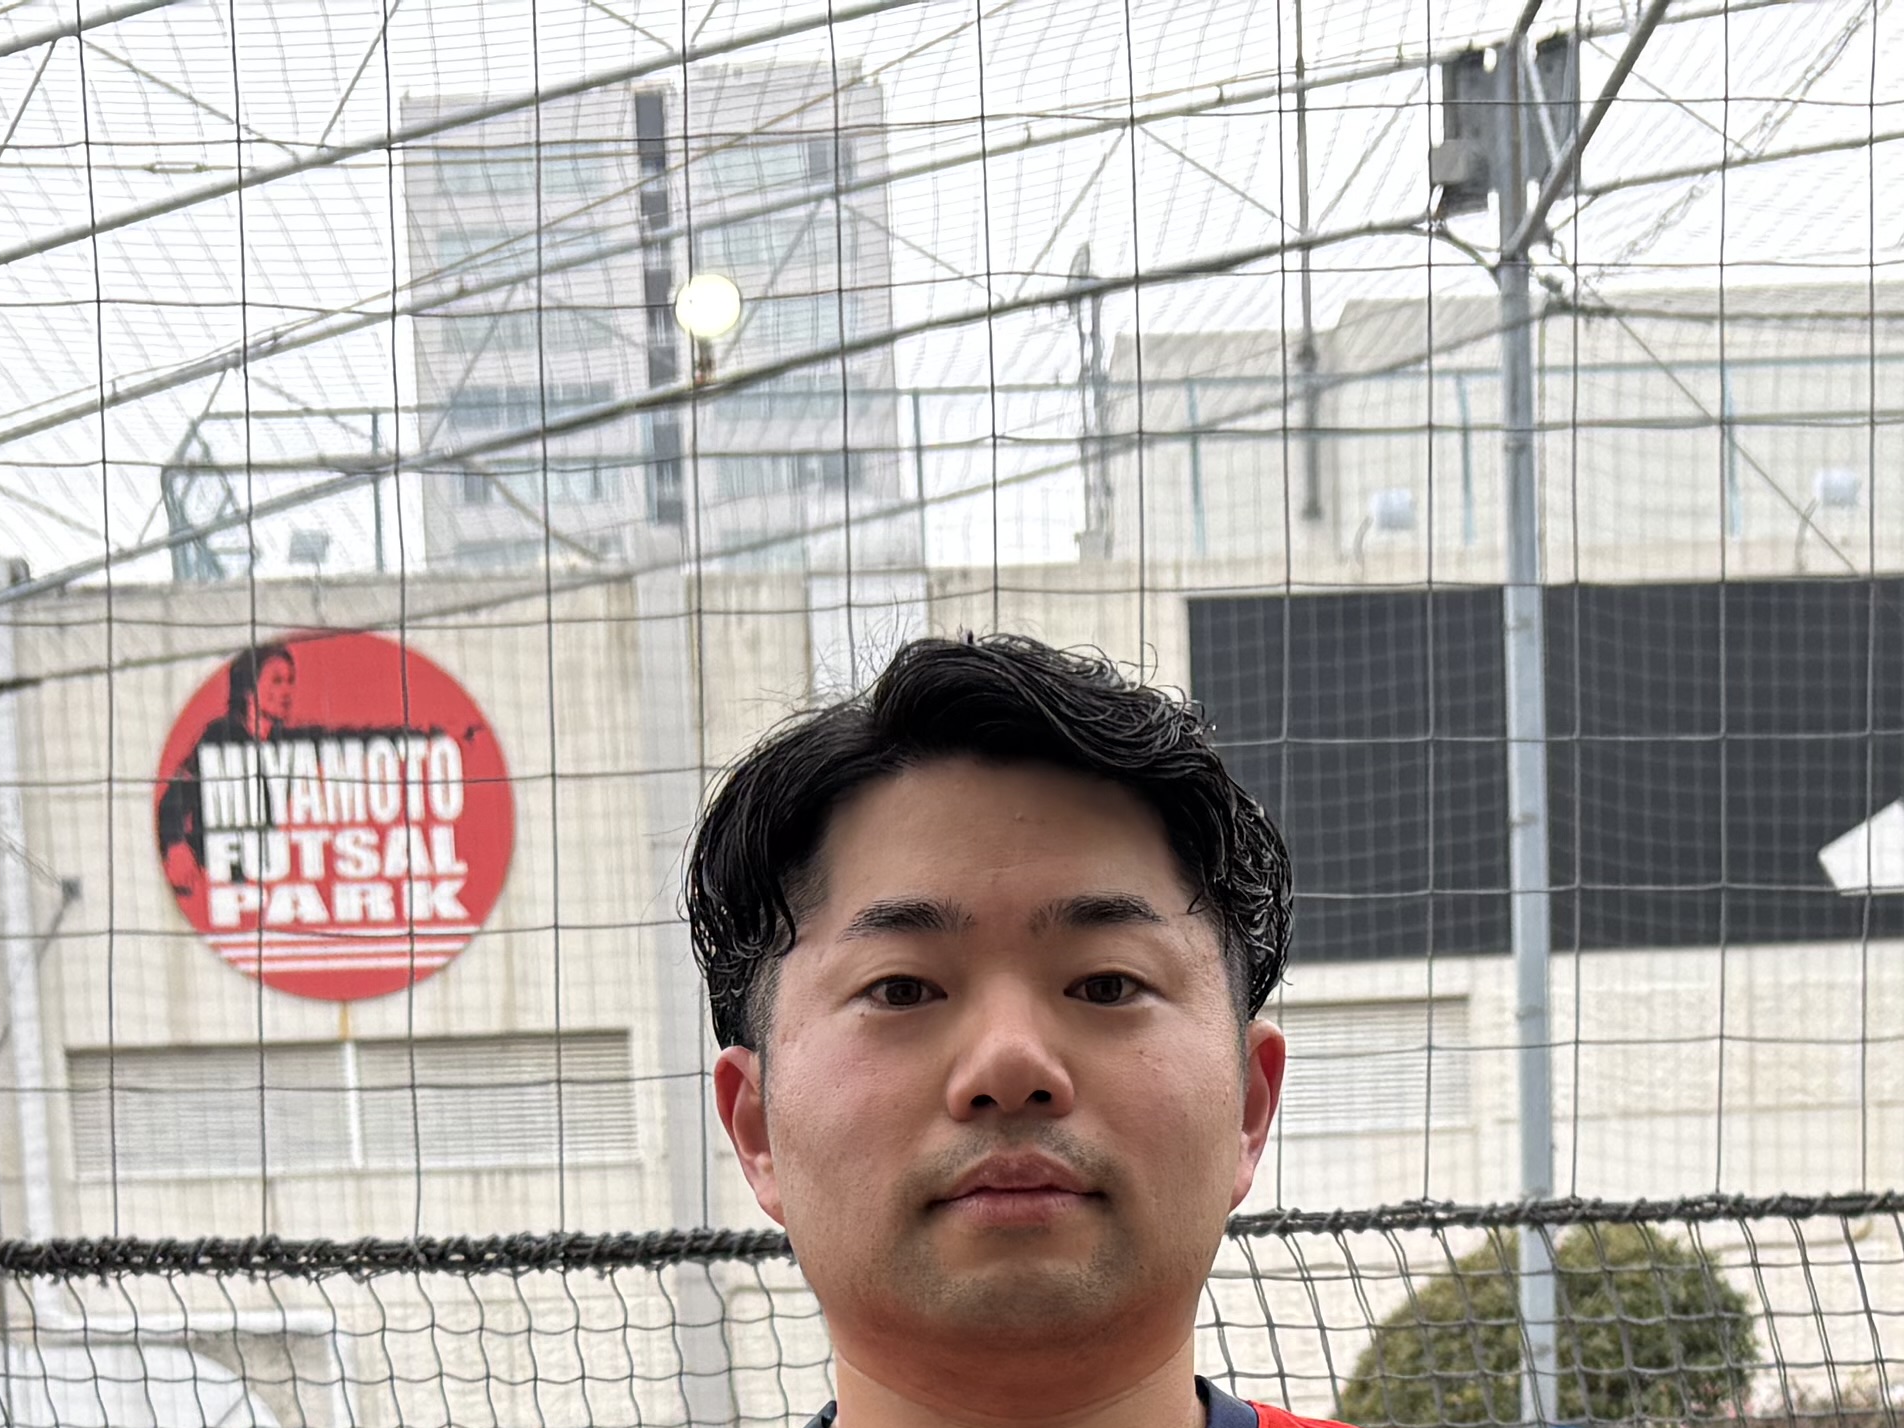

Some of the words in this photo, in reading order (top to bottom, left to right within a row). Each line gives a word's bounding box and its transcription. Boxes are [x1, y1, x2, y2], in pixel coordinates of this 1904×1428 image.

[198, 735, 465, 828] MIYAMOTO
[205, 824, 469, 883] FUTSAL
[207, 878, 471, 929] PARK
